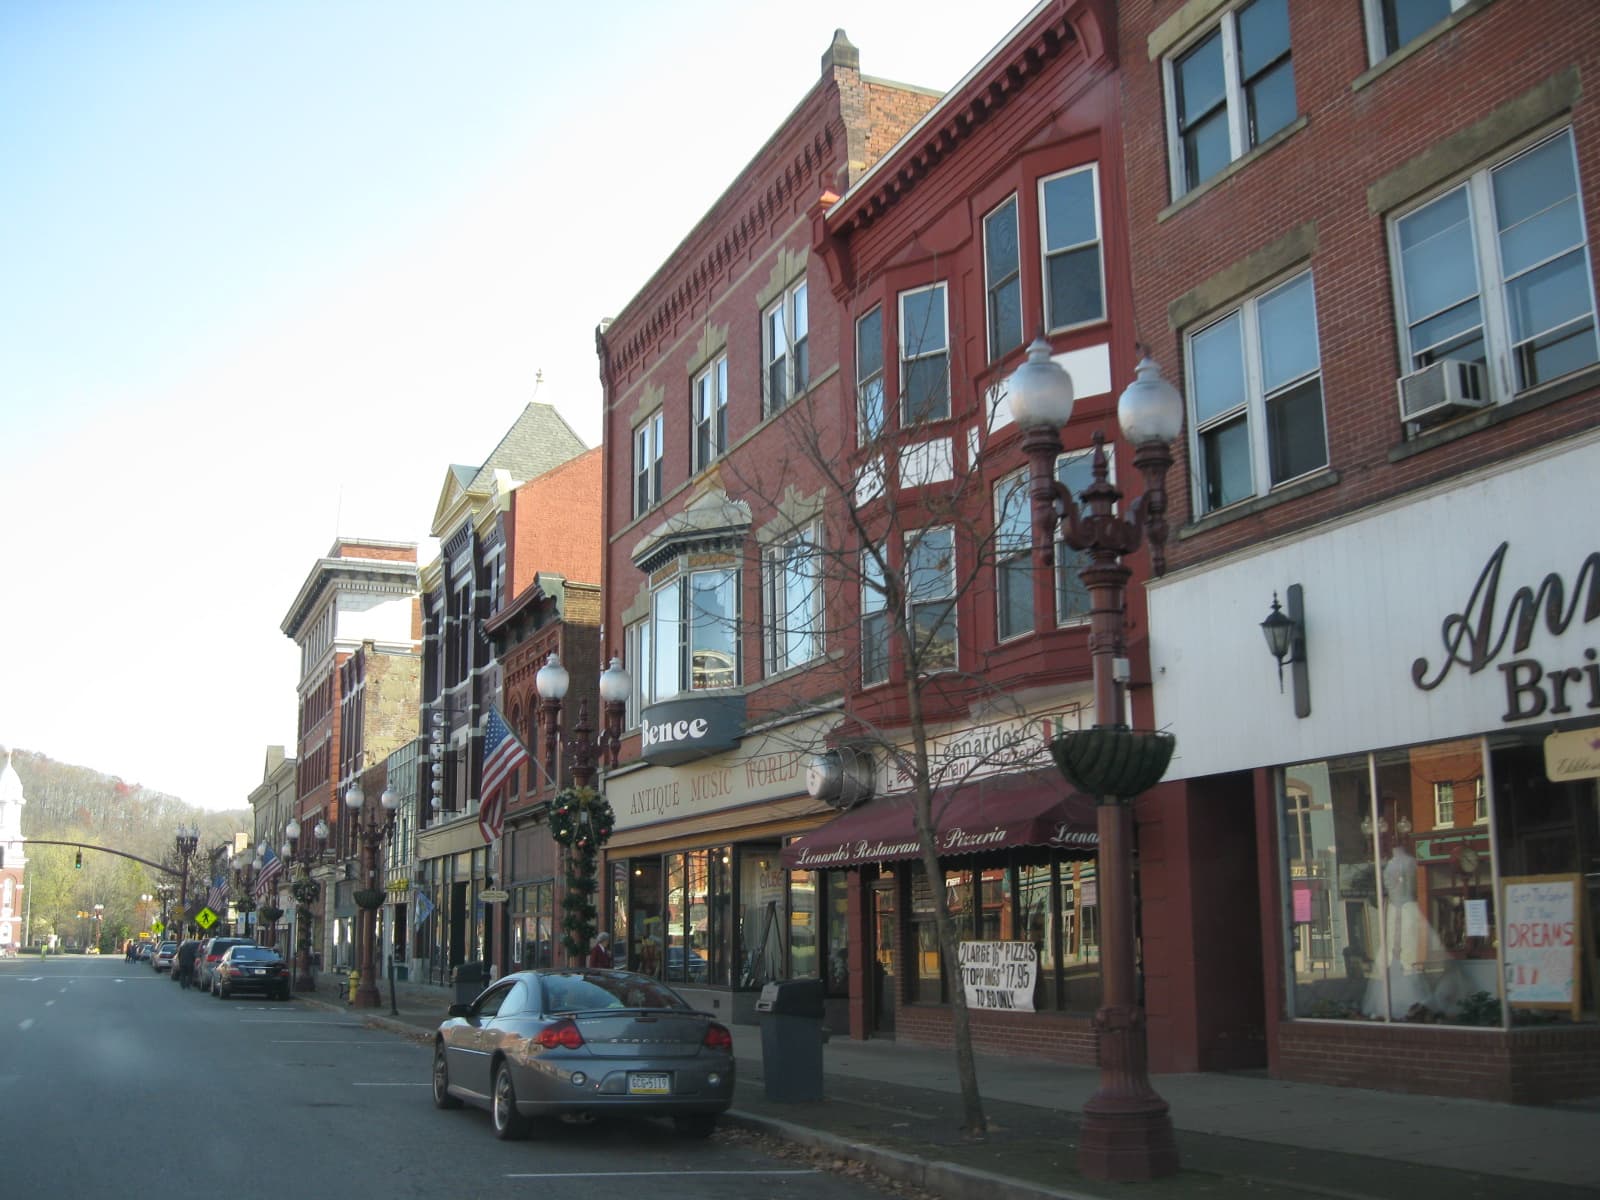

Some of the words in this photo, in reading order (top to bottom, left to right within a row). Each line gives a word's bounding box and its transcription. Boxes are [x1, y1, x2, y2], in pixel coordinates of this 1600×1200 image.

[642, 719, 707, 748] Bence
[630, 782, 680, 815] ANTIQUE
[690, 769, 732, 801] MUSIC
[745, 752, 798, 789] WORLD
[795, 843, 850, 866] Leonardo's
[942, 827, 1007, 849] Pizzeria
[1507, 921, 1576, 948] DREAMS
[966, 944, 991, 963] LARGE
[1006, 943, 1036, 962] PIZZAS
[966, 967, 1001, 987] TOPPINGS
[1001, 963, 1030, 989] $17.95
[975, 988, 985, 1007] TO
[986, 989, 997, 1008] GO
[997, 989, 1016, 1008] ONLY
